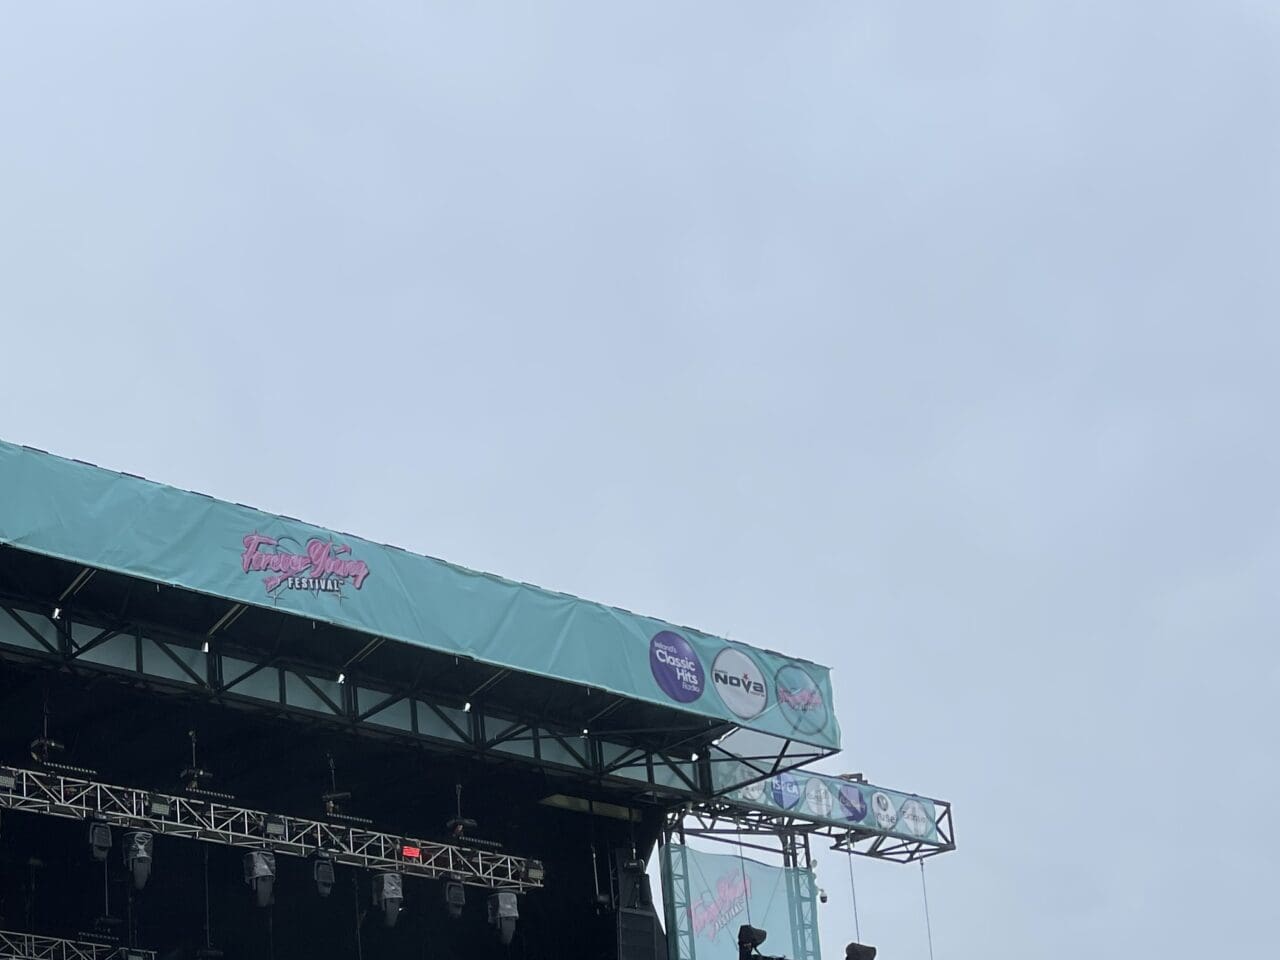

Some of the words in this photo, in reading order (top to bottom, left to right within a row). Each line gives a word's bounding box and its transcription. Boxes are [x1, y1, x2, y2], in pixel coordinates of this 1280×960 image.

[241, 530, 312, 592] Forever
[306, 538, 370, 590] Young
[287, 577, 342, 592] FESTIVAL
[656, 649, 696, 671] Classic
[676, 667, 698, 685] Hits
